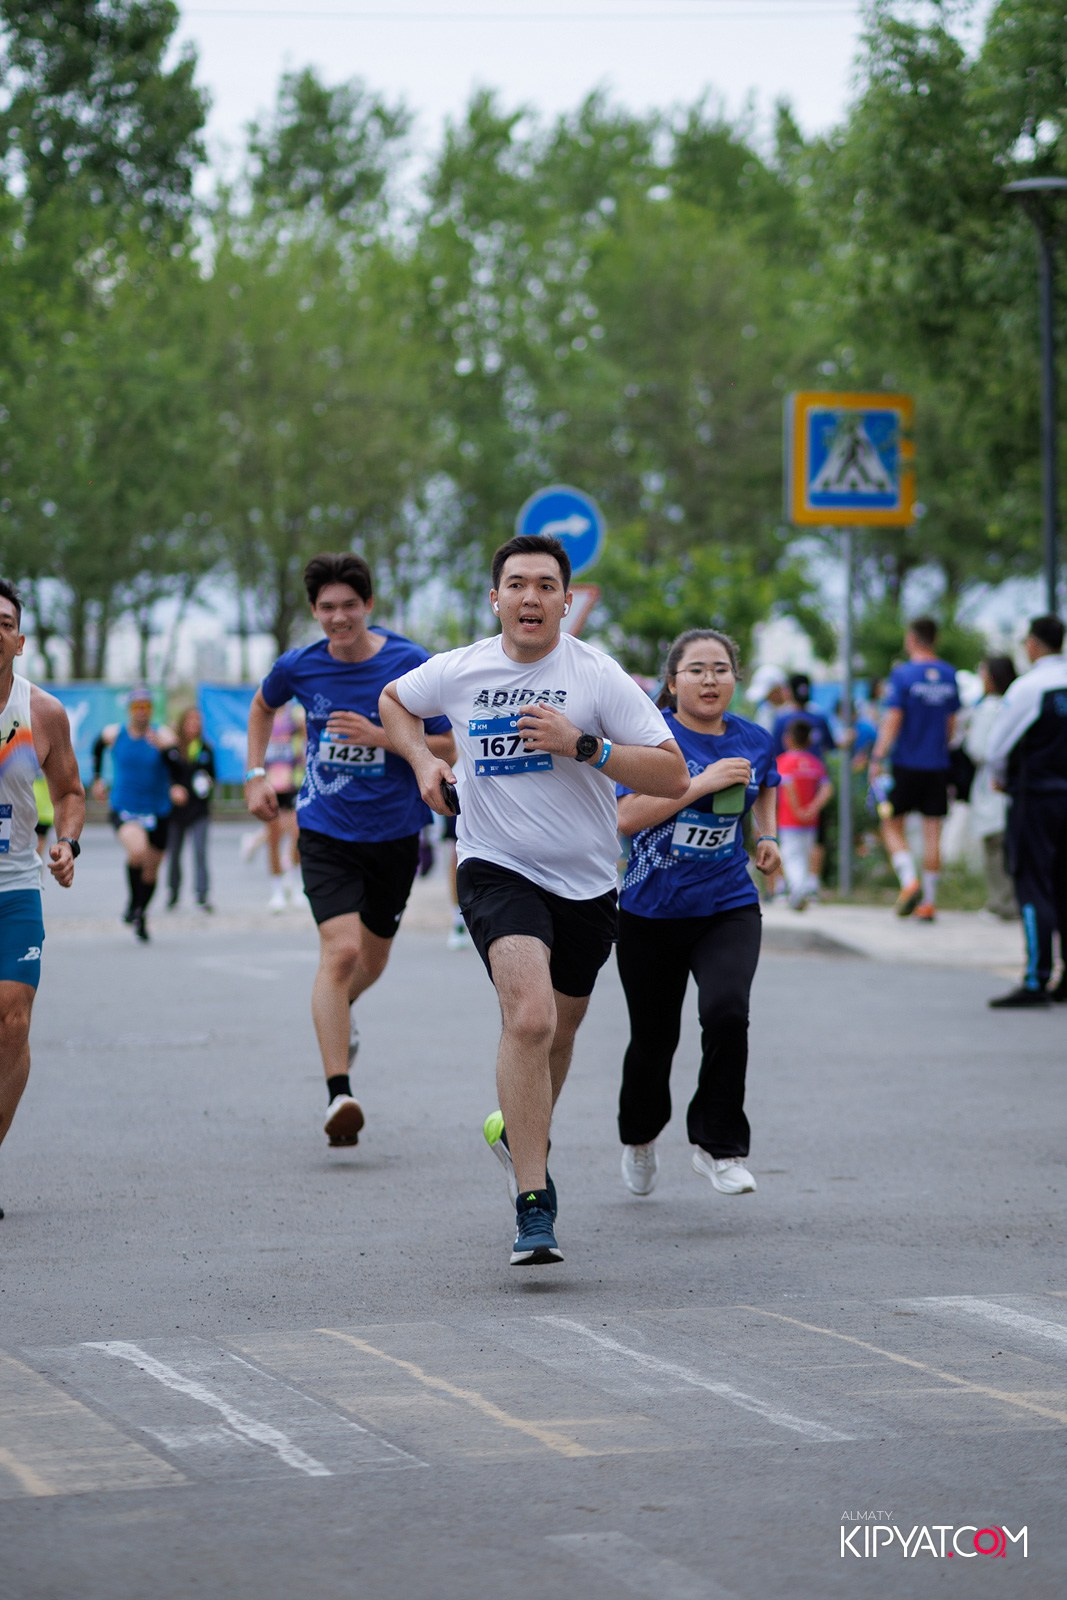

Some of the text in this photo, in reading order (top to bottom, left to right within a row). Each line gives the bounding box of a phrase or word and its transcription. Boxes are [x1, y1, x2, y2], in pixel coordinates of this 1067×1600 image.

[474, 688, 567, 708] ADIDAS
[477, 723, 488, 731] KM
[328, 746, 377, 762] 1423
